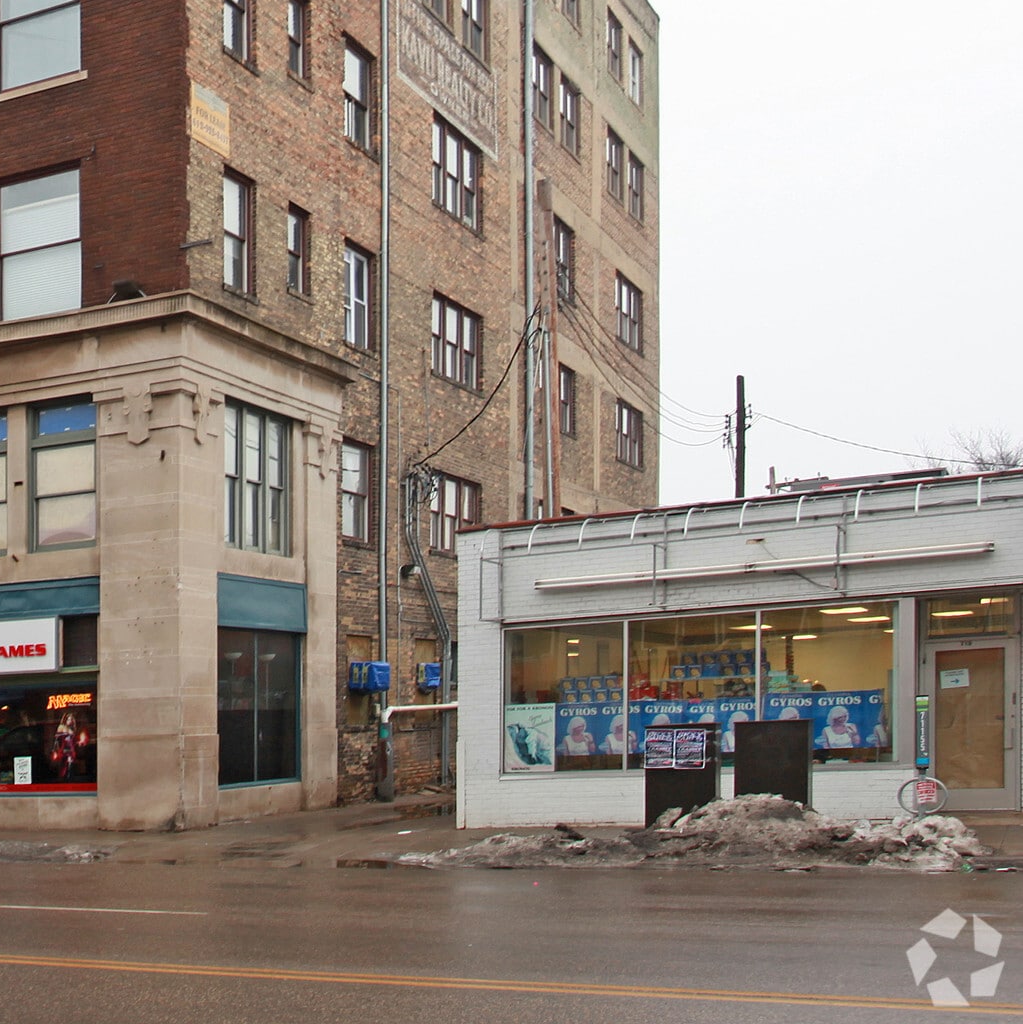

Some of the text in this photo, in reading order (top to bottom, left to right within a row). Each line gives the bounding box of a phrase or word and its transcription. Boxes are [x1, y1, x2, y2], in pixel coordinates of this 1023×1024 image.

[770, 697, 813, 707] GYROS
[817, 695, 861, 706] GYROS
[559, 707, 598, 717] GYROS
[644, 705, 683, 714] GYROS
